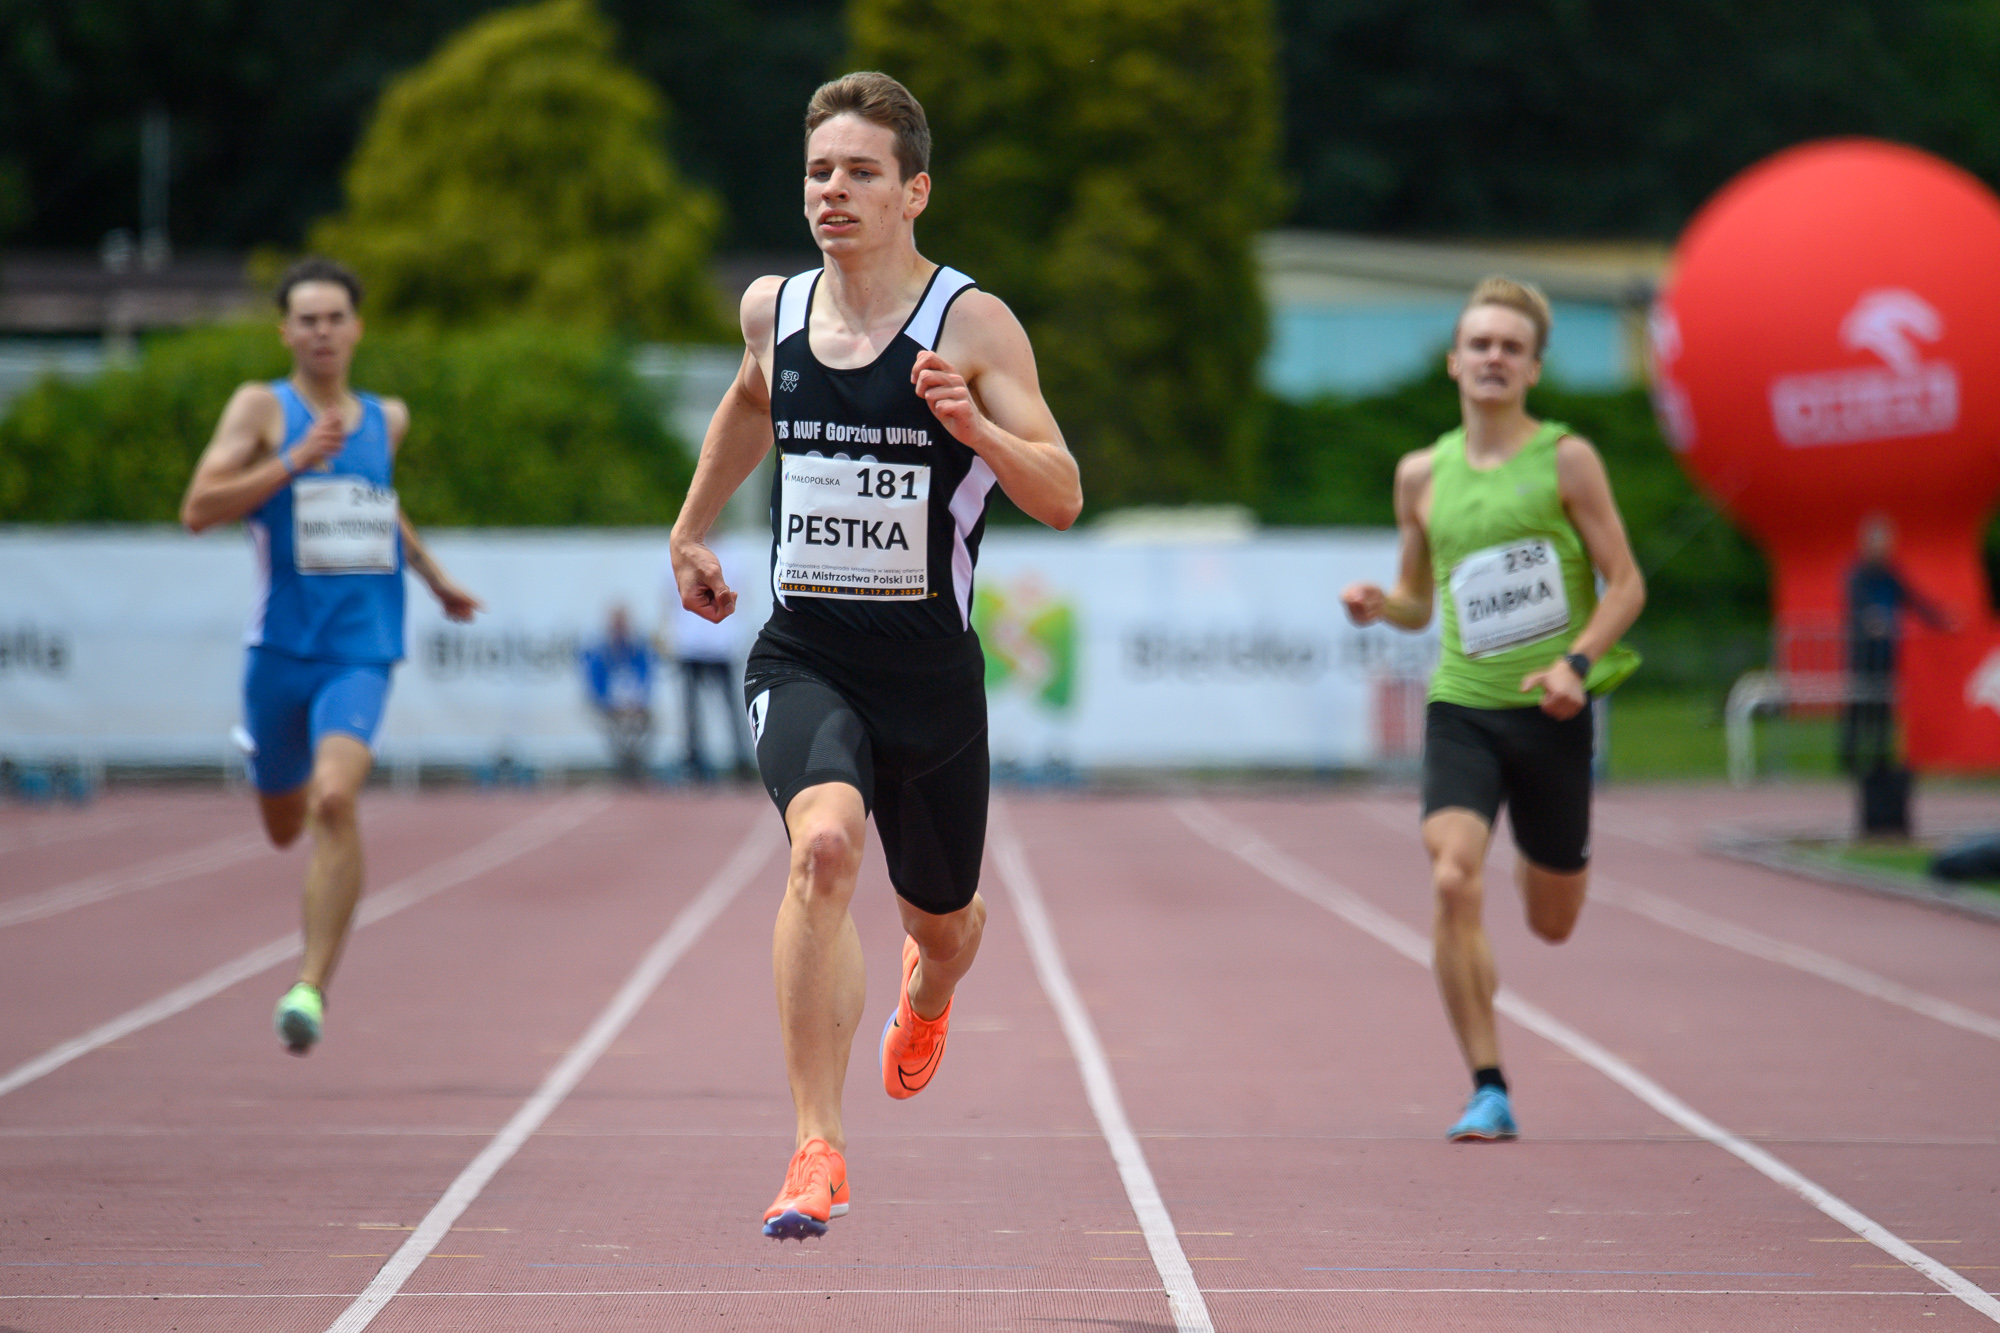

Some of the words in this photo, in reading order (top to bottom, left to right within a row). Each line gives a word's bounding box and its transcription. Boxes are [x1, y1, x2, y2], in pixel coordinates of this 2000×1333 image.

[776, 421, 788, 439] ZS
[794, 420, 821, 439] AWF
[826, 422, 881, 444] Gorzów
[886, 427, 932, 447] Wlkp.
[791, 474, 840, 486] MAŁOPOLSKA
[856, 468, 918, 500] 181
[787, 514, 909, 551] PESTKA
[786, 569, 808, 579] PZLA
[812, 571, 870, 583] Mistrzostwa
[873, 575, 902, 584] Polski
[906, 574, 924, 583] U18
[854, 588, 922, 596] 15-17.07.2022
